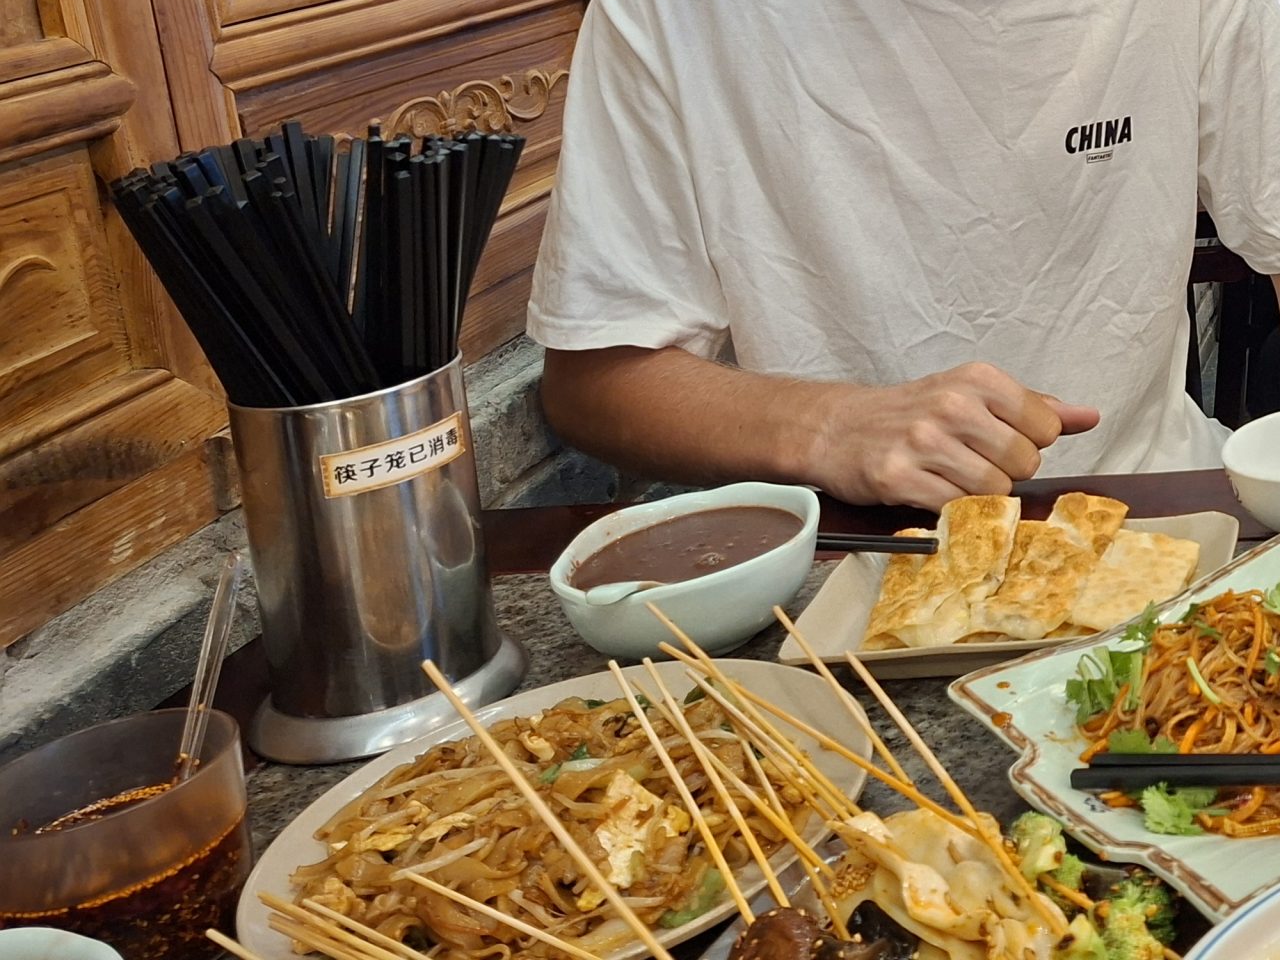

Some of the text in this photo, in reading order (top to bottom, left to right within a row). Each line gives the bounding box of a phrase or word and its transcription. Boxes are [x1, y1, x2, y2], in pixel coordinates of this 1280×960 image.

[1065, 116, 1132, 155] CHINA
[334, 427, 458, 484] 筷子笼已消毒
